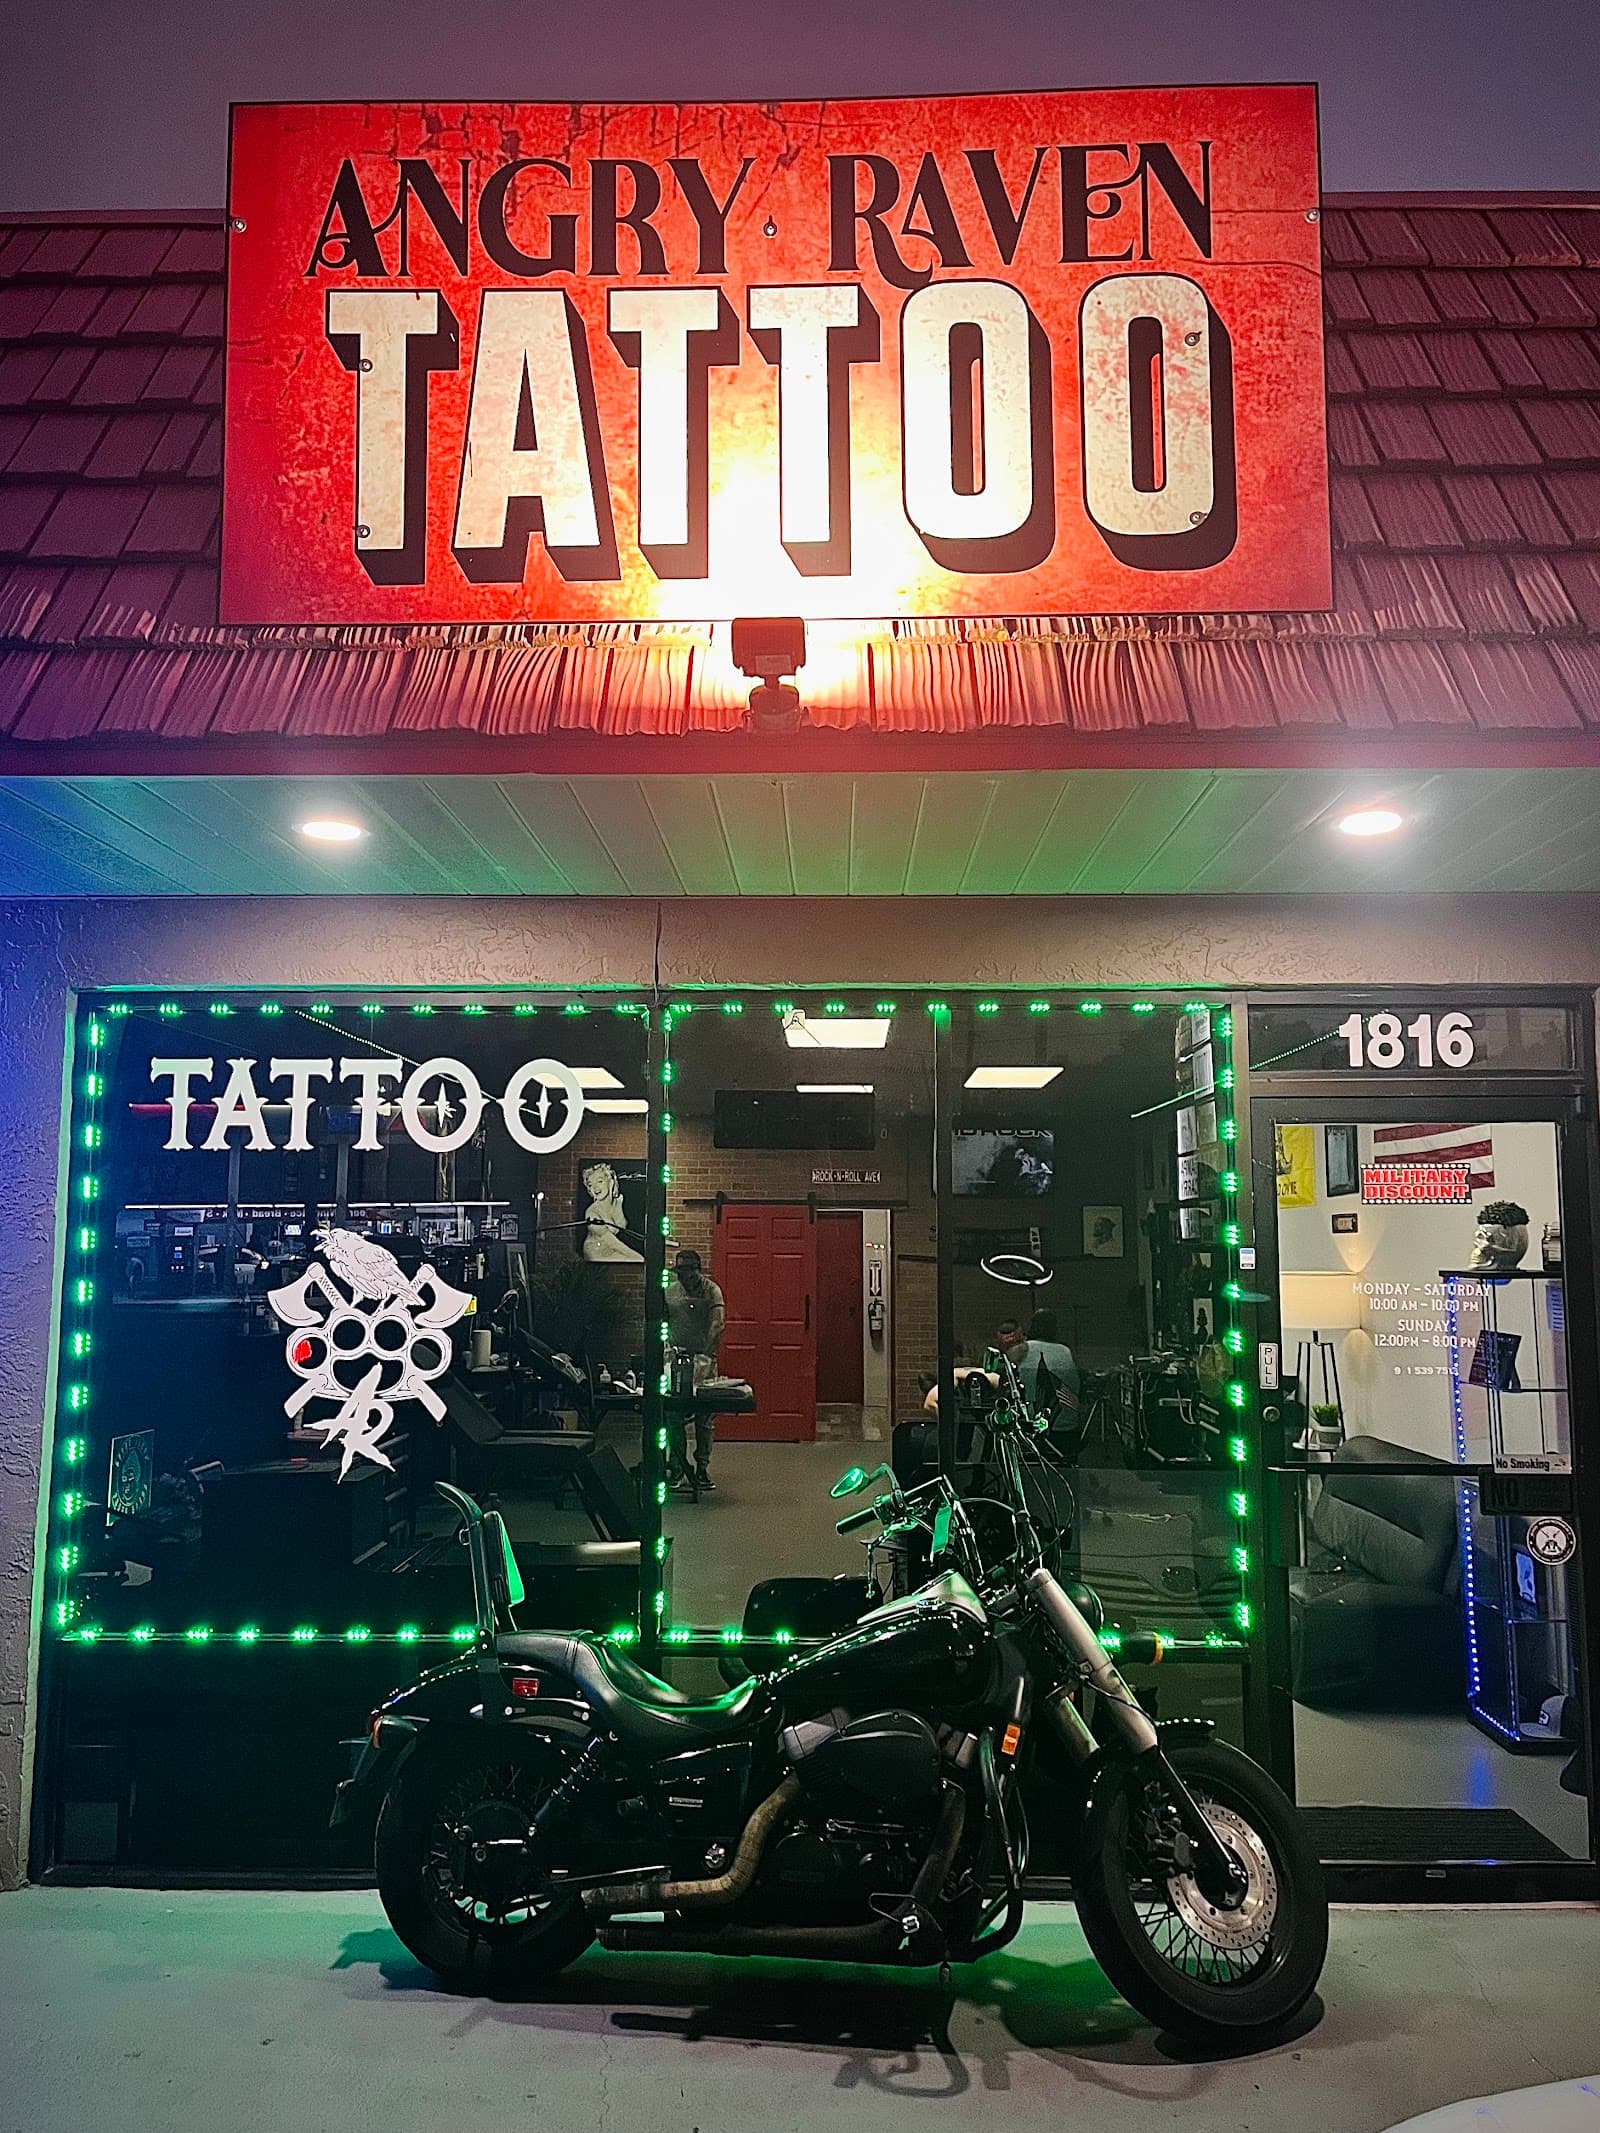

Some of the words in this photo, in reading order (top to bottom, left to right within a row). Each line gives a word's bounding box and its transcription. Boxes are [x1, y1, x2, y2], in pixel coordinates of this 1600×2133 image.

[304, 156, 751, 278] ANGRY
[828, 140, 1215, 290] RAVEN
[324, 272, 1236, 586] TATTOO
[1338, 1011, 1474, 1069] 1816
[149, 1056, 585, 1154] TATTOO
[1363, 1168, 1468, 1184] MILITARY
[1363, 1184, 1469, 1199] DISCOUNT
[1352, 1282, 1410, 1295] MONDAY
[1424, 1283, 1492, 1296] SATURDAY
[1369, 1298, 1398, 1311] 10:00
[1401, 1301, 1418, 1311] AM
[1431, 1299, 1459, 1312] 10:00
[1463, 1302, 1479, 1312] PM
[1398, 1319, 1450, 1332] SUNDAY
[1432, 1335, 1458, 1348] 8:00
[1460, 1338, 1476, 1348] PM
[1264, 1347, 1273, 1385] PULL
[303, 1361, 397, 1484] AR
[1495, 1458, 1508, 1469] No
[1510, 1458, 1550, 1472] Smoking
